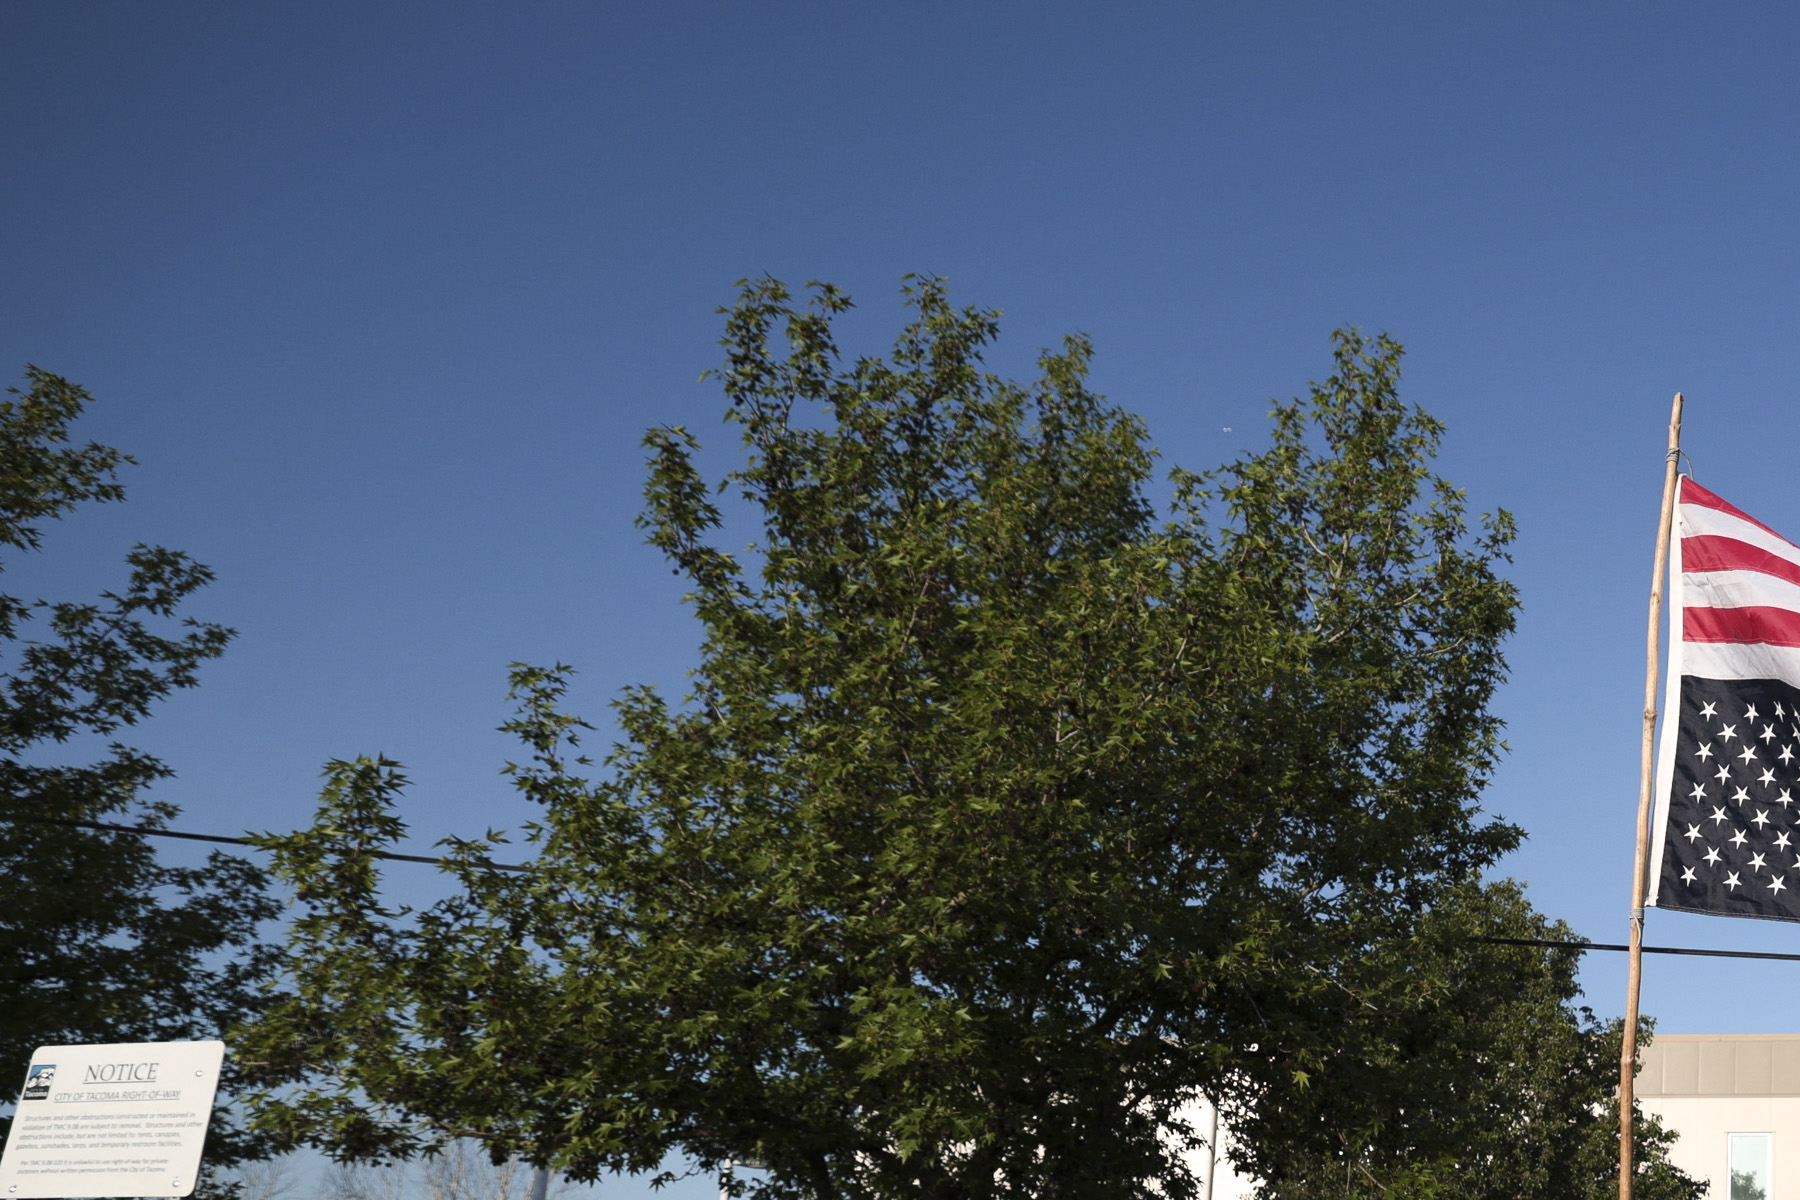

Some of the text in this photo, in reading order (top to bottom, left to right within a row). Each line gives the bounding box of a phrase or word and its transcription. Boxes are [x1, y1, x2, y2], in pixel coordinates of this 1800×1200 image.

[84, 1063, 160, 1081] NOTICE
[54, 1093, 73, 1101] CITY
[73, 1092, 84, 1101] OF
[86, 1091, 120, 1100] TACOMA
